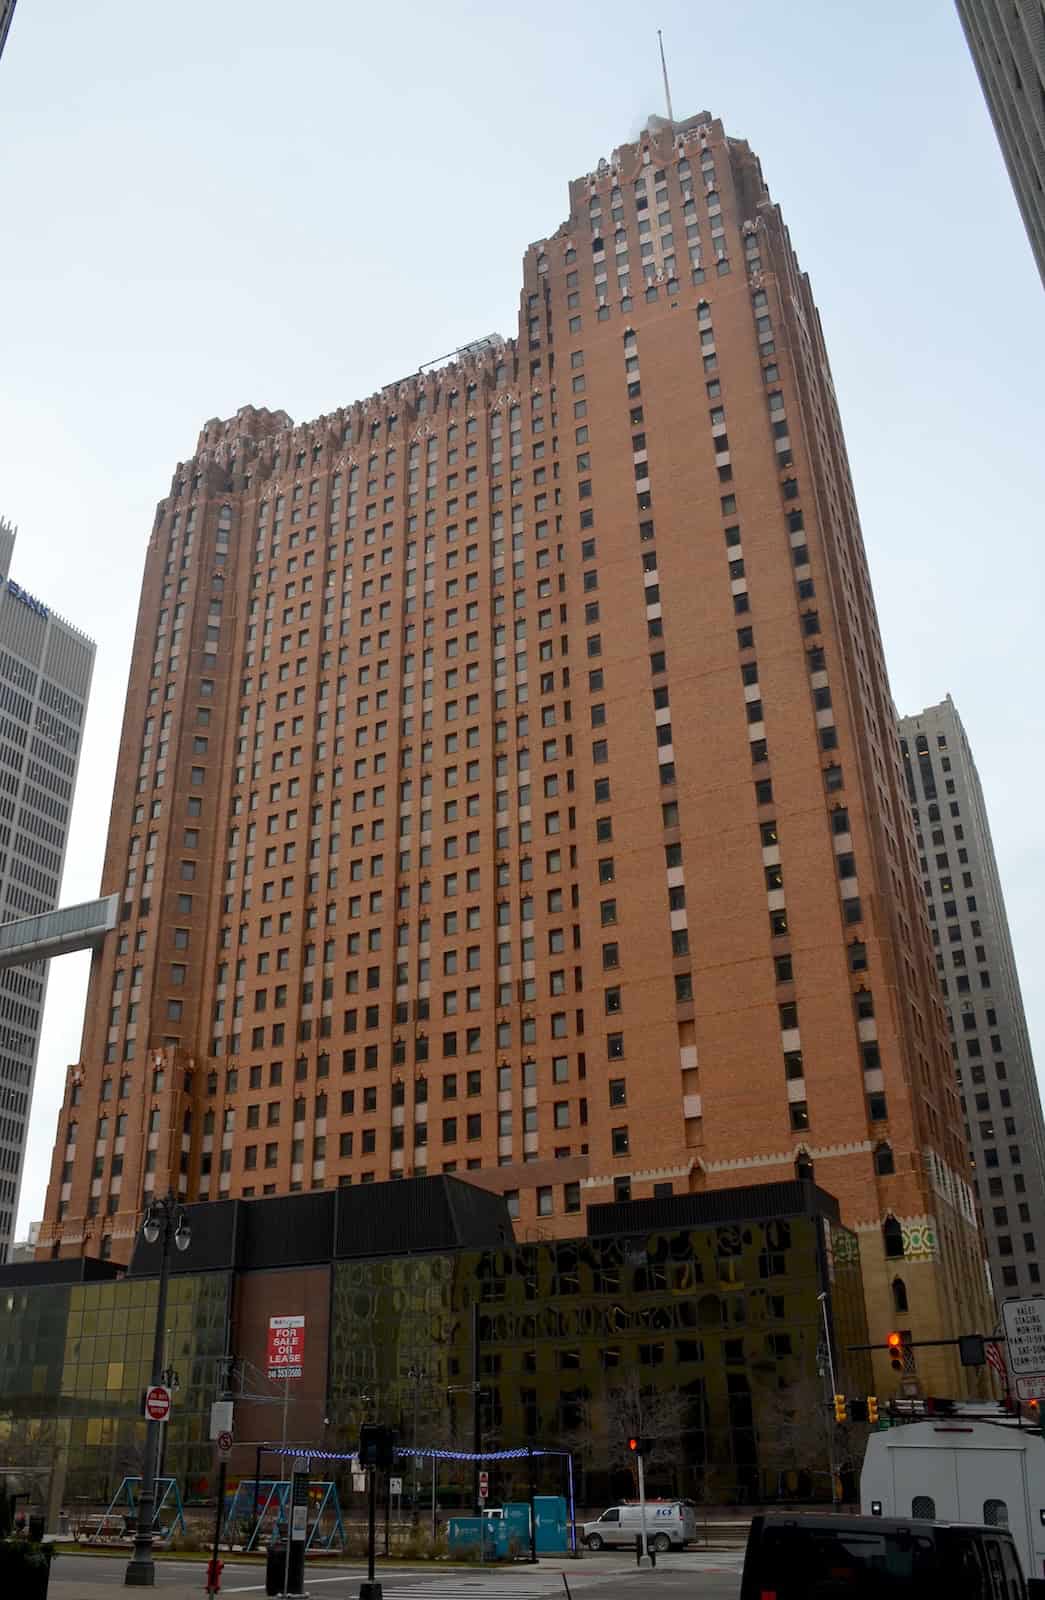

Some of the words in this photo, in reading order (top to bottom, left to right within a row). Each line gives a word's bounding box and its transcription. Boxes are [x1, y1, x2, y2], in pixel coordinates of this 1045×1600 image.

[8, 579, 49, 620] BANK
[275, 1328, 297, 1337] FOR
[273, 1337, 299, 1346] SALE
[278, 1346, 293, 1354] OR
[269, 1354, 302, 1363] LEASE
